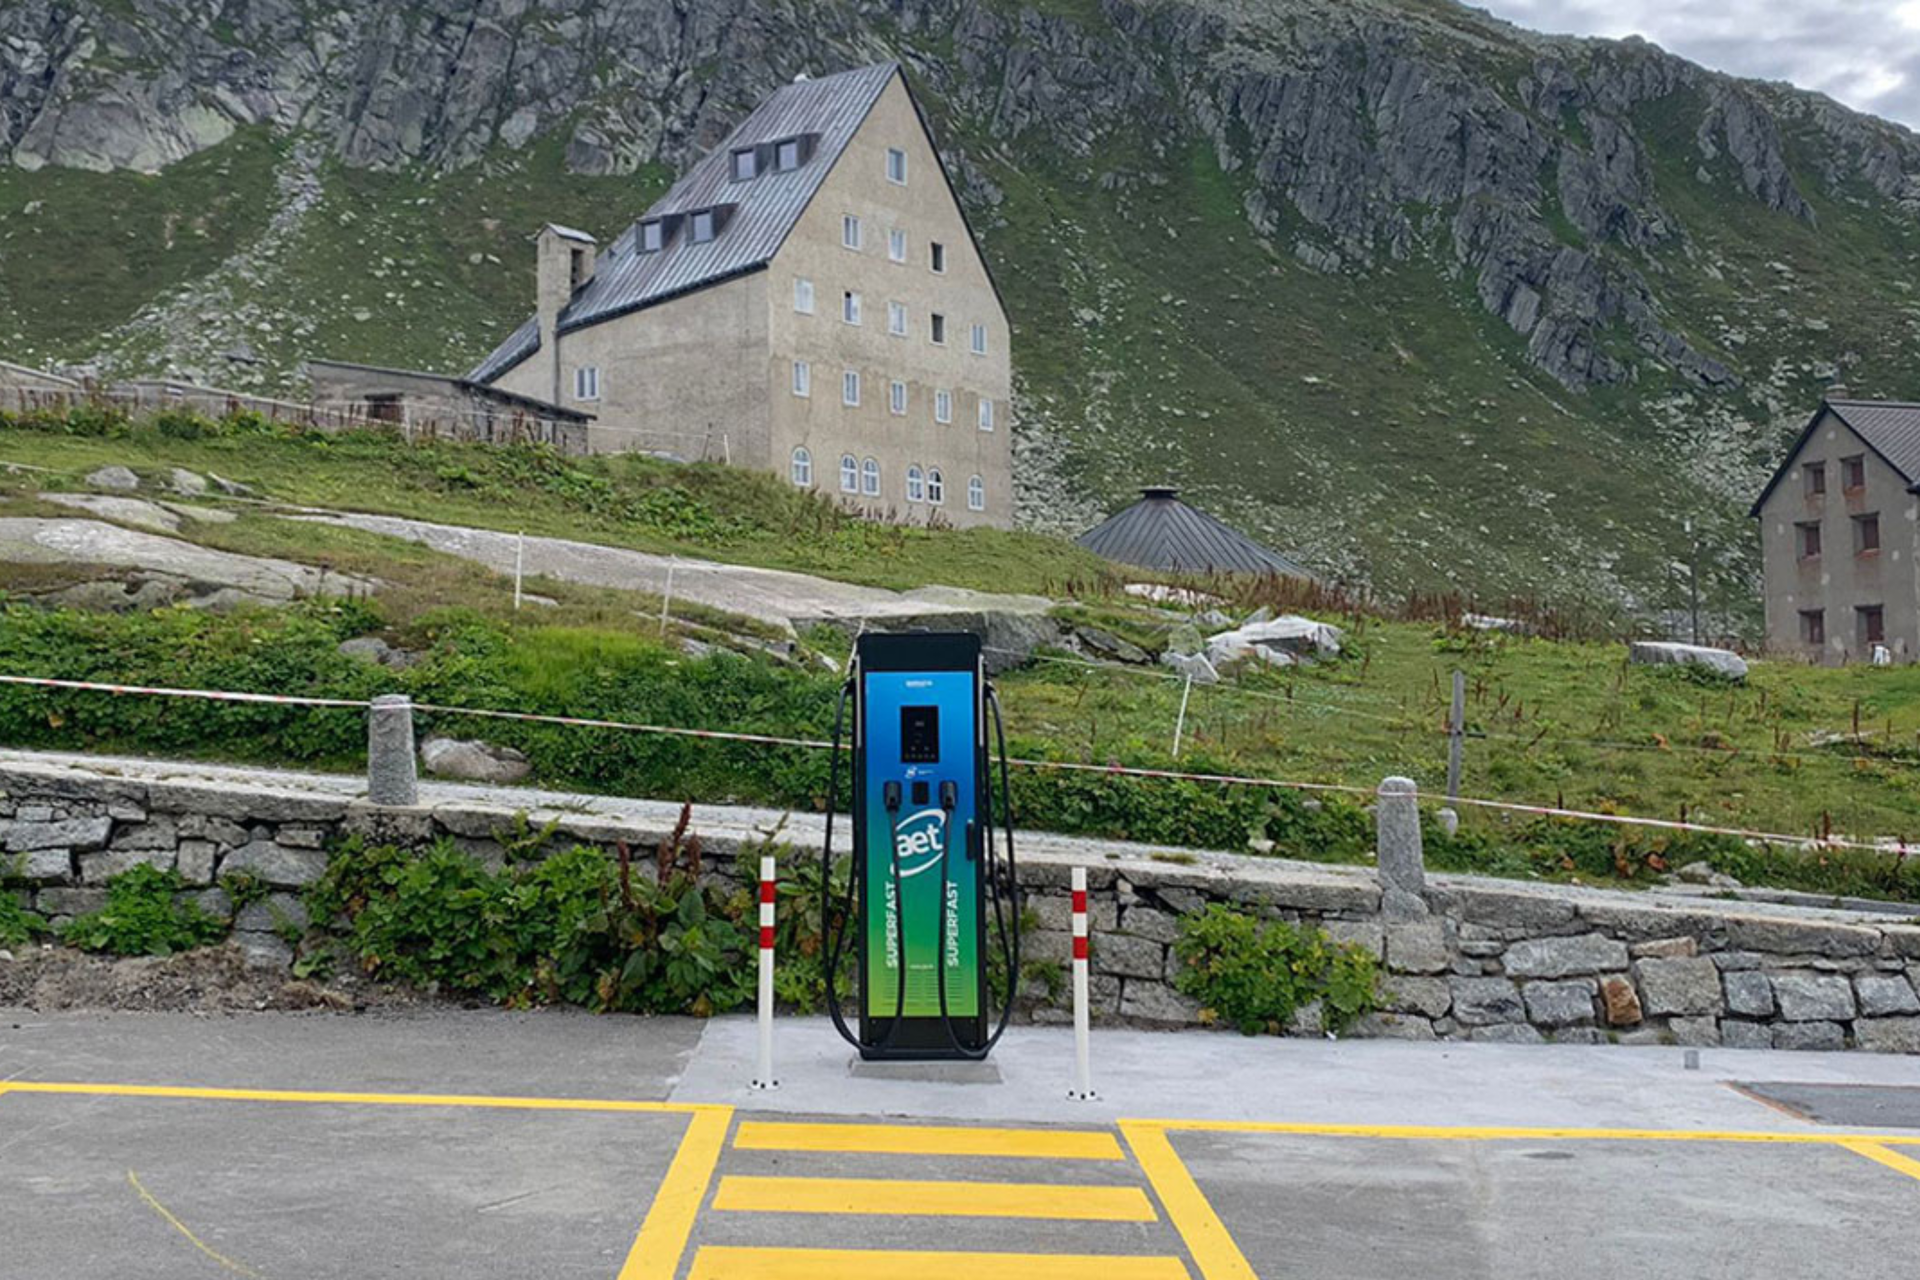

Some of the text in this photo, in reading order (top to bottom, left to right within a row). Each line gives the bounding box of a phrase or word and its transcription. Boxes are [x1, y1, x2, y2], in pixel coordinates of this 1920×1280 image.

[896, 823, 943, 857] aet
[885, 881, 898, 969] SUPERFAST
[946, 880, 959, 967] SUPERFAST
